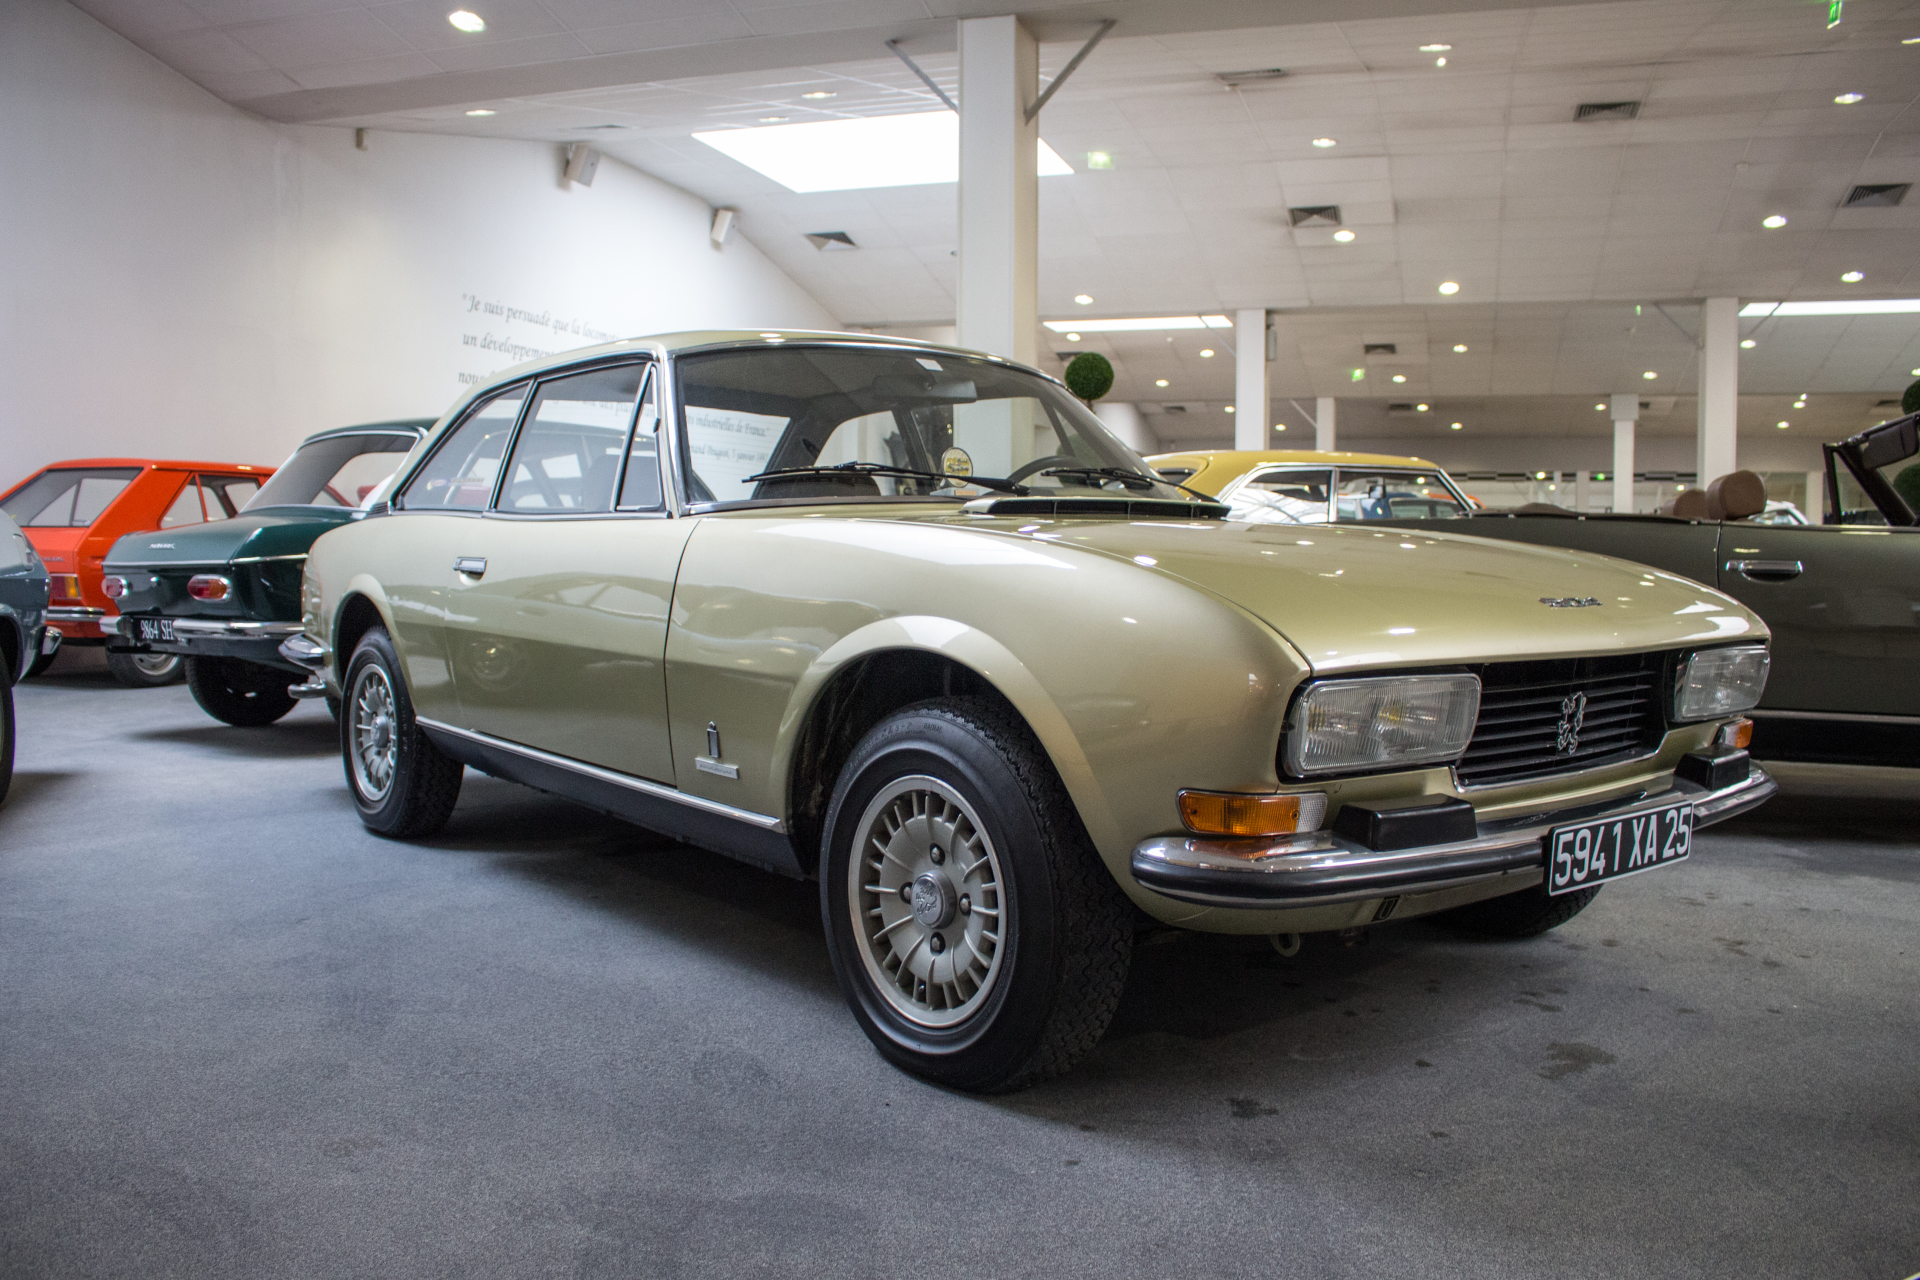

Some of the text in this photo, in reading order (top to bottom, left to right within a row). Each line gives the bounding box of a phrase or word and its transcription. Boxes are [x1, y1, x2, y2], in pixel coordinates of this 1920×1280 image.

[483, 299, 504, 316] suis
[505, 306, 550, 327] persuadé
[552, 319, 569, 335] que
[571, 318, 581, 335] la
[462, 333, 478, 348] un
[458, 371, 485, 386] nou
[140, 619, 159, 640] 9864
[1554, 806, 1692, 886] 5941 XA 25
